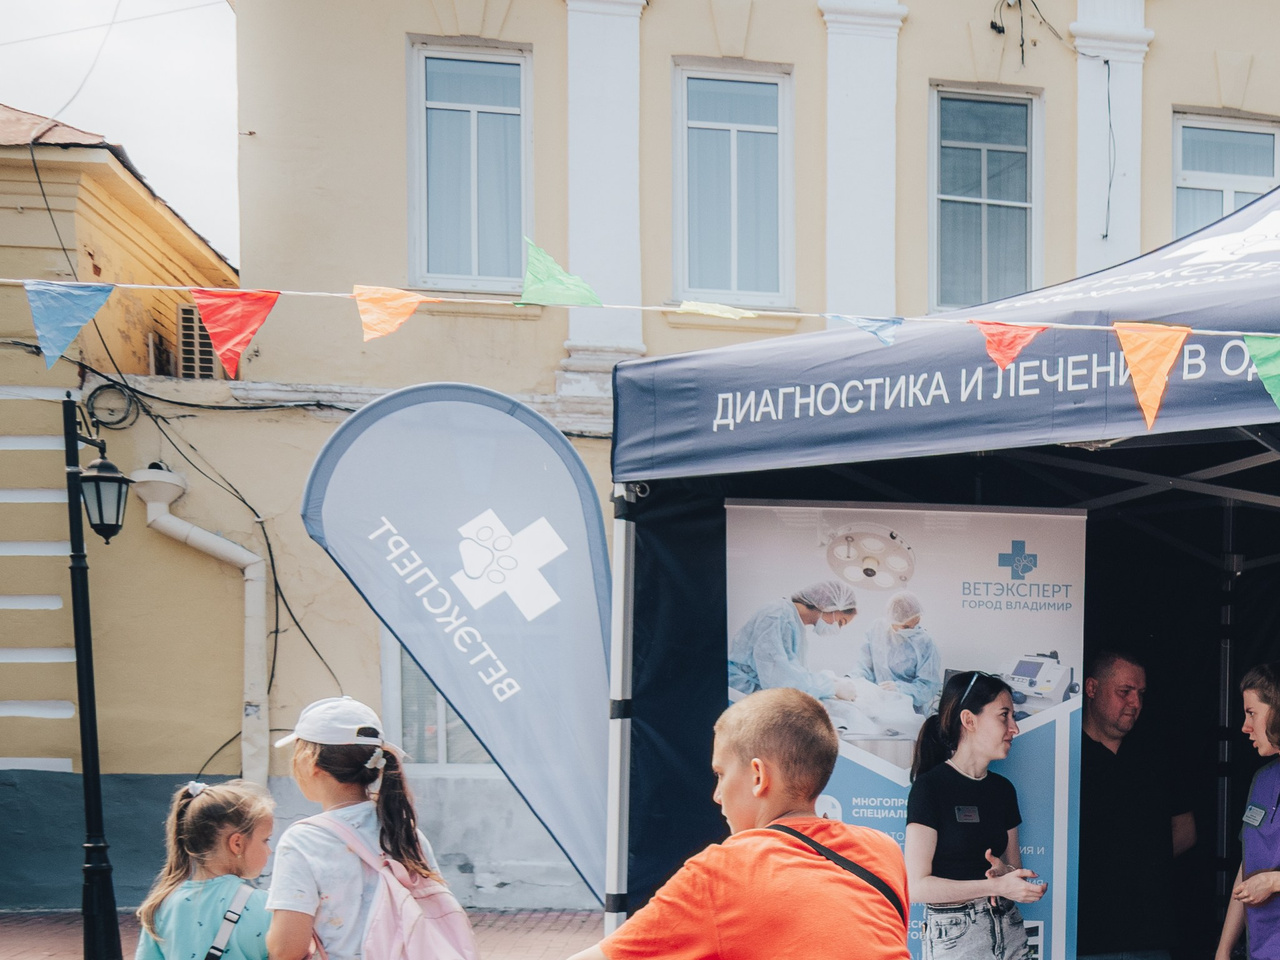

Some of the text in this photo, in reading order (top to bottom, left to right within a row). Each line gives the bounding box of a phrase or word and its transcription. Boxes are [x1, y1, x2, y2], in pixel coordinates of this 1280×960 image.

[711, 372, 950, 432] ДИАГНОСТИКА
[959, 364, 985, 402] И
[993, 351, 1168, 400] ЛЕЧЕН
[1182, 343, 1207, 381] В
[961, 581, 1073, 599] ВЕТЭКСПЕРТ
[961, 599, 1073, 612] ГОРОД ВЛАДИМИР
